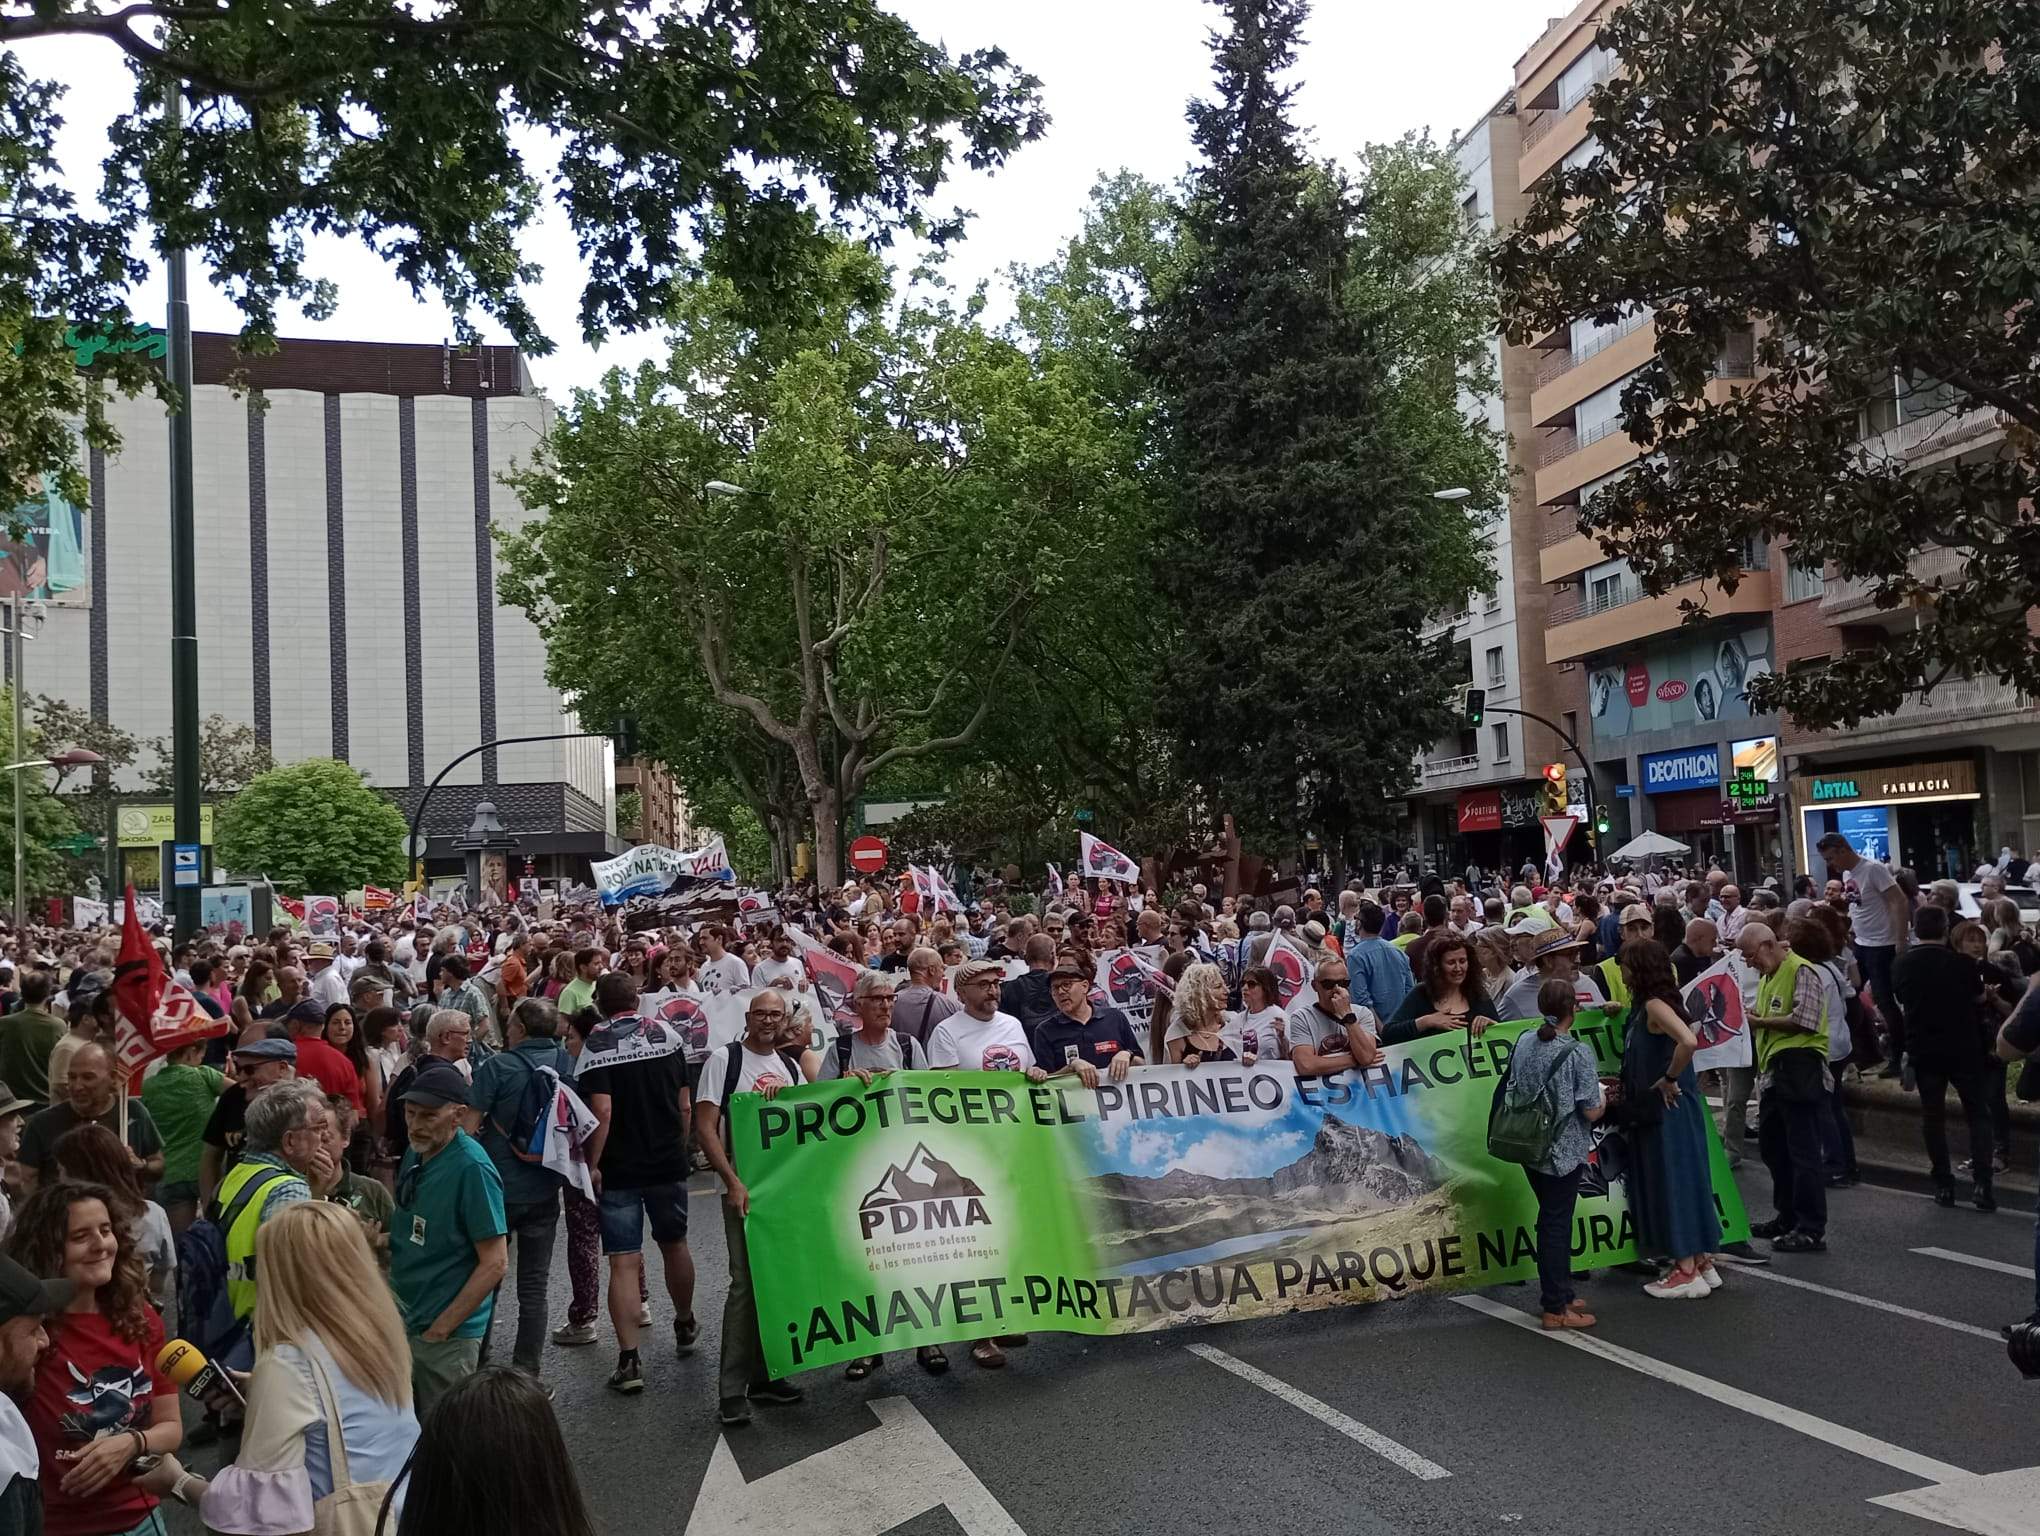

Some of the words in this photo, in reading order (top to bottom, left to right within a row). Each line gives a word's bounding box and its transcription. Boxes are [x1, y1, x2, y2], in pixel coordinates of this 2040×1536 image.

[1657, 684, 1686, 699] SVENSON
[1648, 753, 1718, 784] DECATHLON
[1730, 783, 1765, 796] 24H
[1812, 779, 1859, 800] ARTAL
[1882, 778, 1950, 795] FARMACIA
[1460, 800, 1498, 823] SPORTIUM
[690, 851, 722, 876] YA!!
[758, 1086, 1021, 1150] PROTEGER
[1031, 1087, 1085, 1127] EL
[1098, 1074, 1285, 1122] PIRINEO
[1296, 1070, 1352, 1108] ES
[1361, 1039, 1513, 1099] HACER
[858, 1197, 993, 1240] PDMA
[865, 1240, 922, 1257] Plataforma
[924, 1239, 937, 1248] en
[939, 1233, 977, 1246] Defensa
[868, 1261, 881, 1272] de
[883, 1257, 900, 1270] las
[902, 1251, 950, 1267] montañas
[952, 1248, 965, 1260] de
[967, 1246, 1000, 1260] Aragón
[787, 1261, 1263, 1364] ¡ANAYET-PARTACUA
[1276, 1236, 1466, 1299] PARQUE
[189, 1368, 216, 1398] SER
